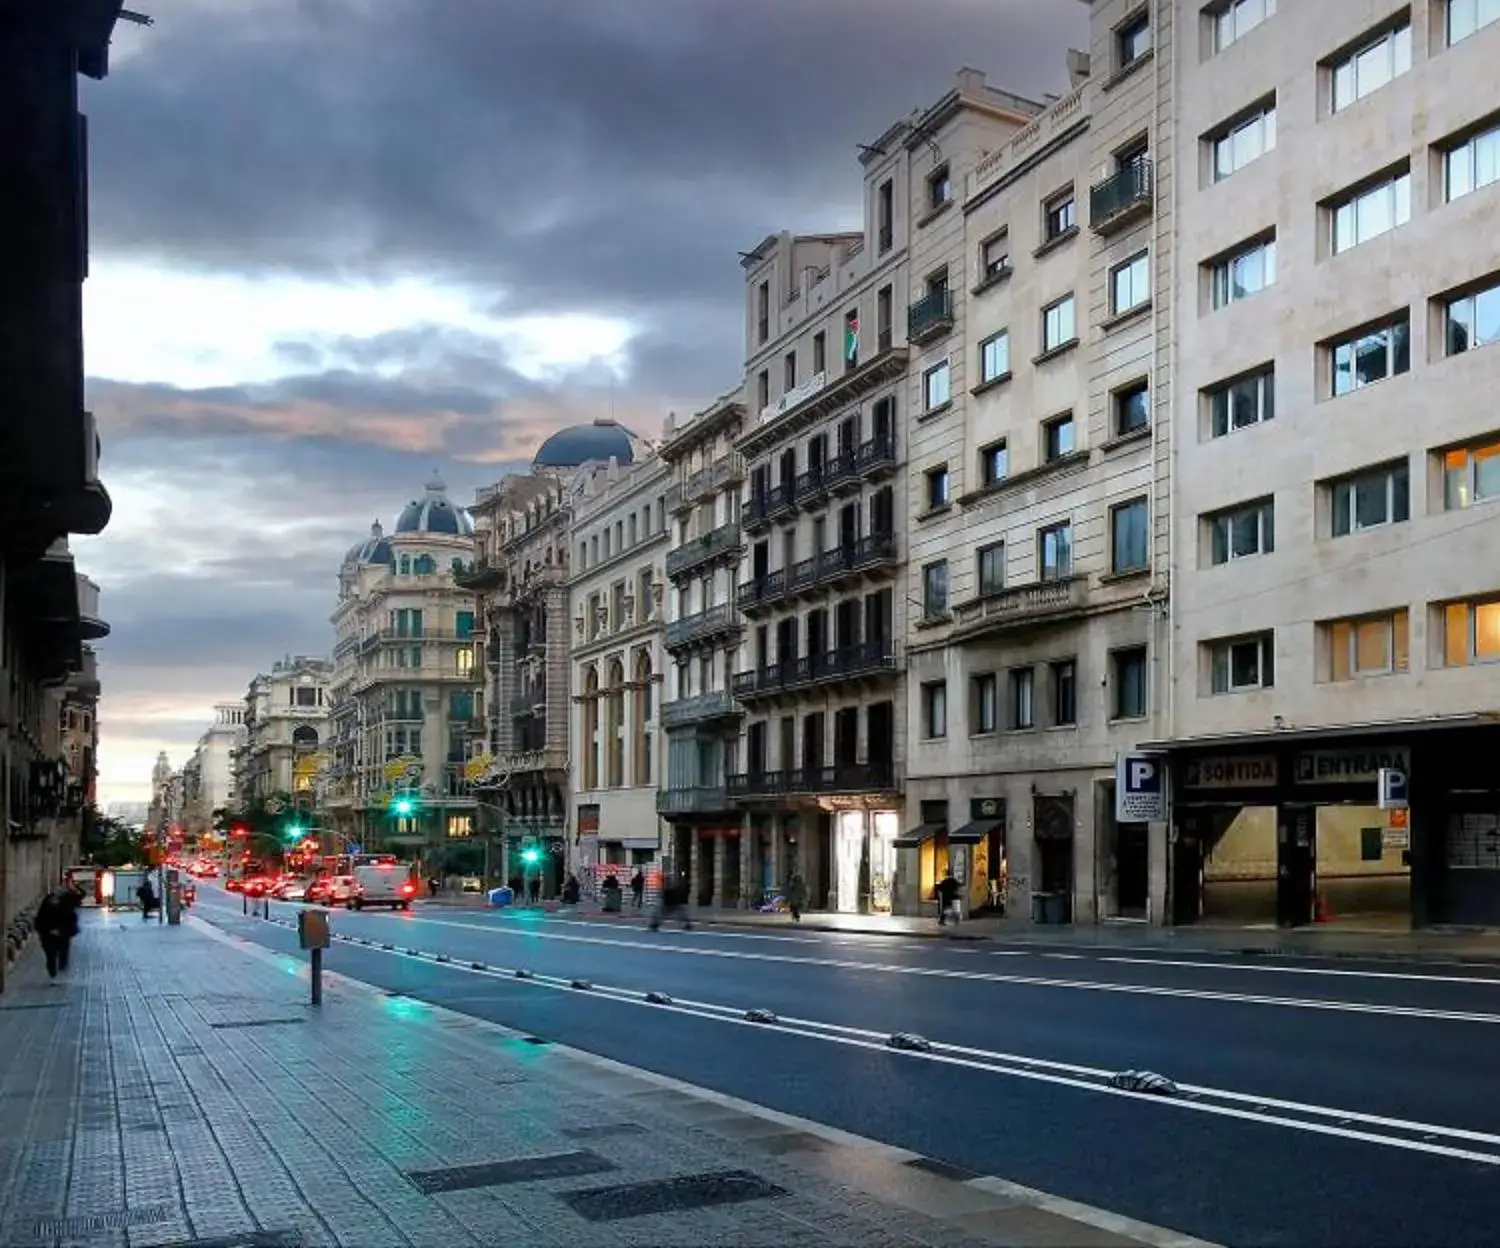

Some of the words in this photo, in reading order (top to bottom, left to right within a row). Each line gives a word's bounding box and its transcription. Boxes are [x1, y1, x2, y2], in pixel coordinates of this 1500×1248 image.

[1131, 762, 1155, 789] P
[1202, 760, 1275, 782] SORTIDA
[1385, 771, 1406, 800] P
